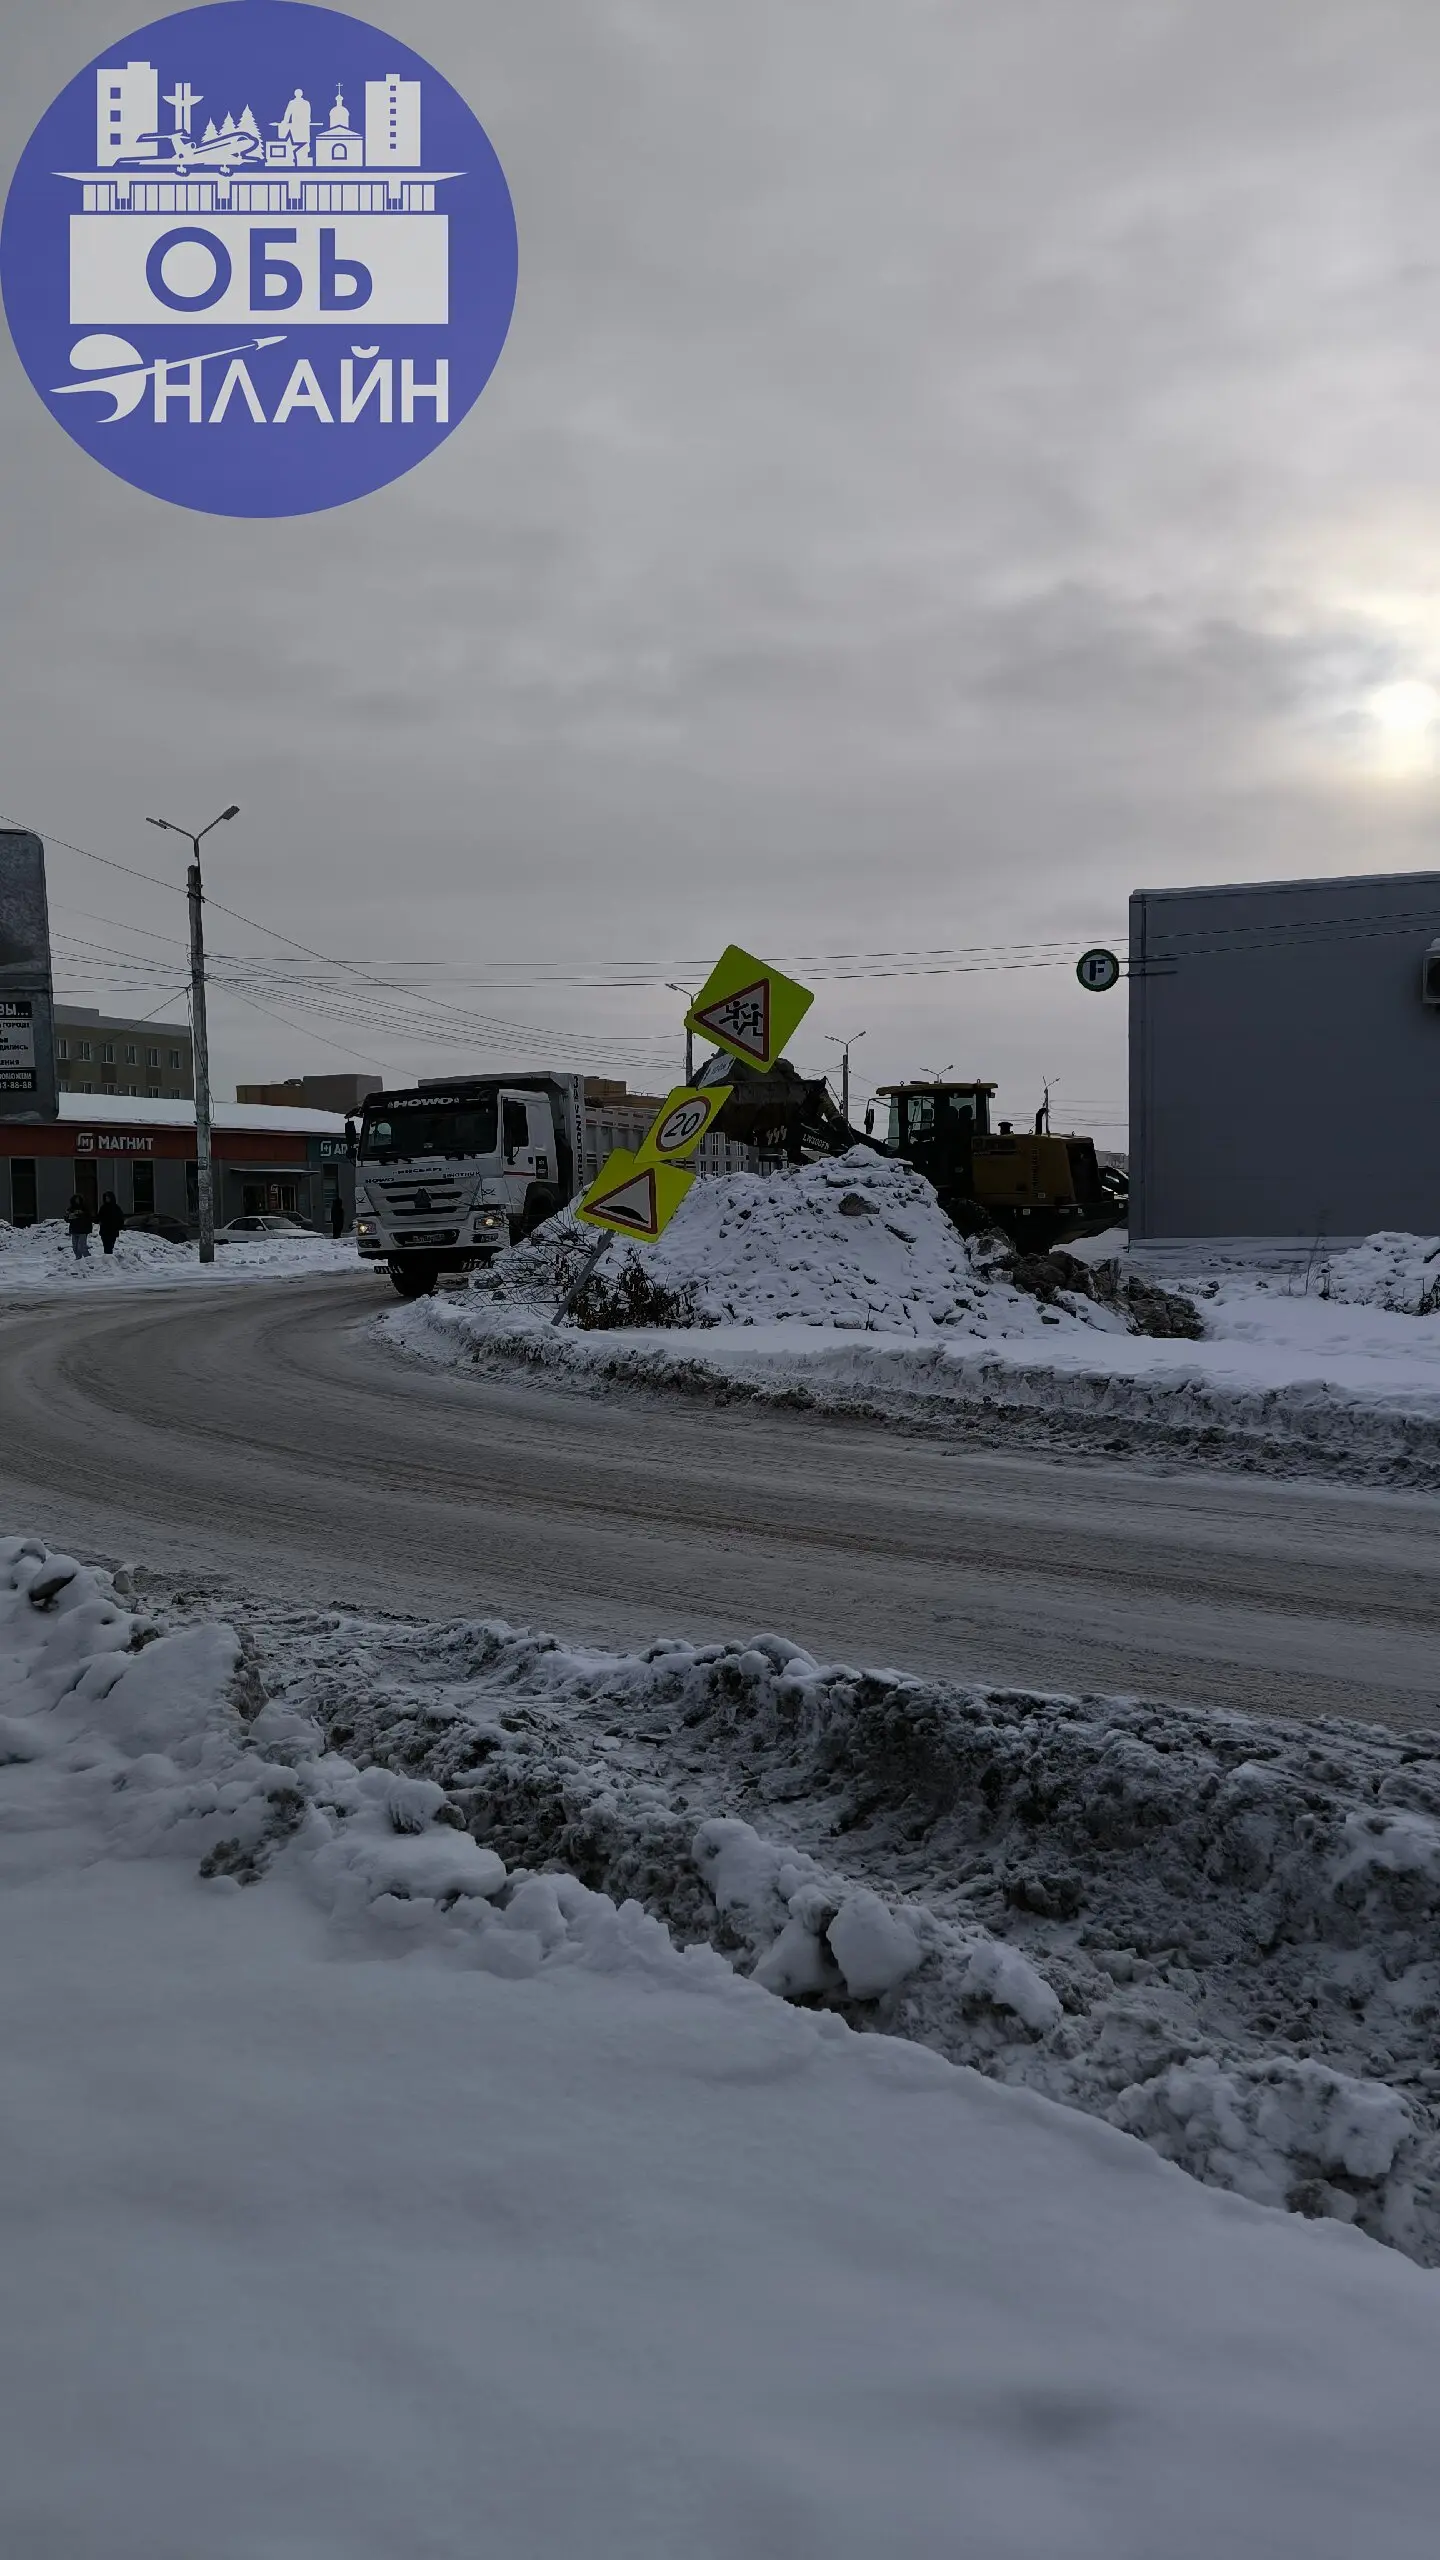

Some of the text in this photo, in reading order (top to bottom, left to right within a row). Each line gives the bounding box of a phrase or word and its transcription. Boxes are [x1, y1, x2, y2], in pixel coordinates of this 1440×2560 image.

[1090, 960, 1105, 982] F
[394, 1097, 453, 1109] HOWO
[663, 1112, 701, 1138] 20
[98, 1135, 154, 1151] МАГНИТ
